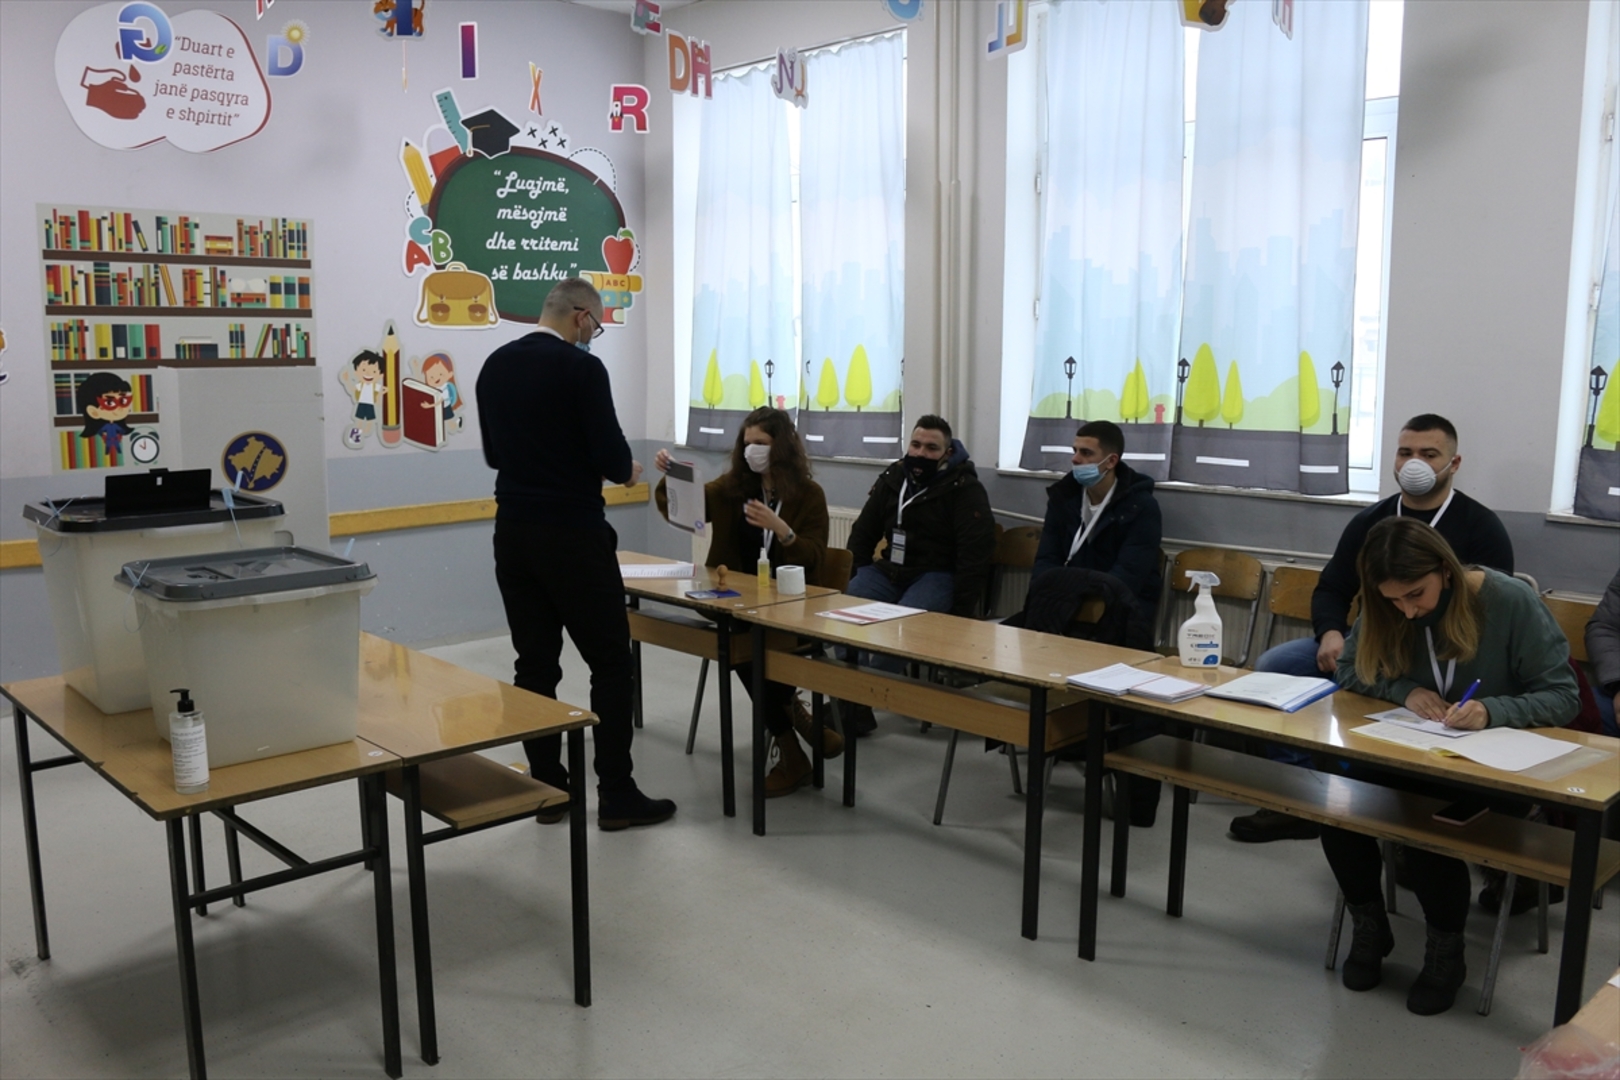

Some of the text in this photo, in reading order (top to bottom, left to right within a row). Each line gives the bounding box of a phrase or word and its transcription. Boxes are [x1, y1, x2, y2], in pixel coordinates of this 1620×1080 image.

[226, 47, 235, 58] e
[268, 35, 303, 76] D
[172, 62, 234, 81] pastërta
[153, 80, 249, 107] janë pasqyra
[166, 107, 175, 119] e
[611, 86, 648, 130] R
[497, 205, 567, 229] mësojmë
[486, 231, 579, 251] dhe rritemi
[491, 265, 508, 280] së
[606, 279, 625, 287] ABC
